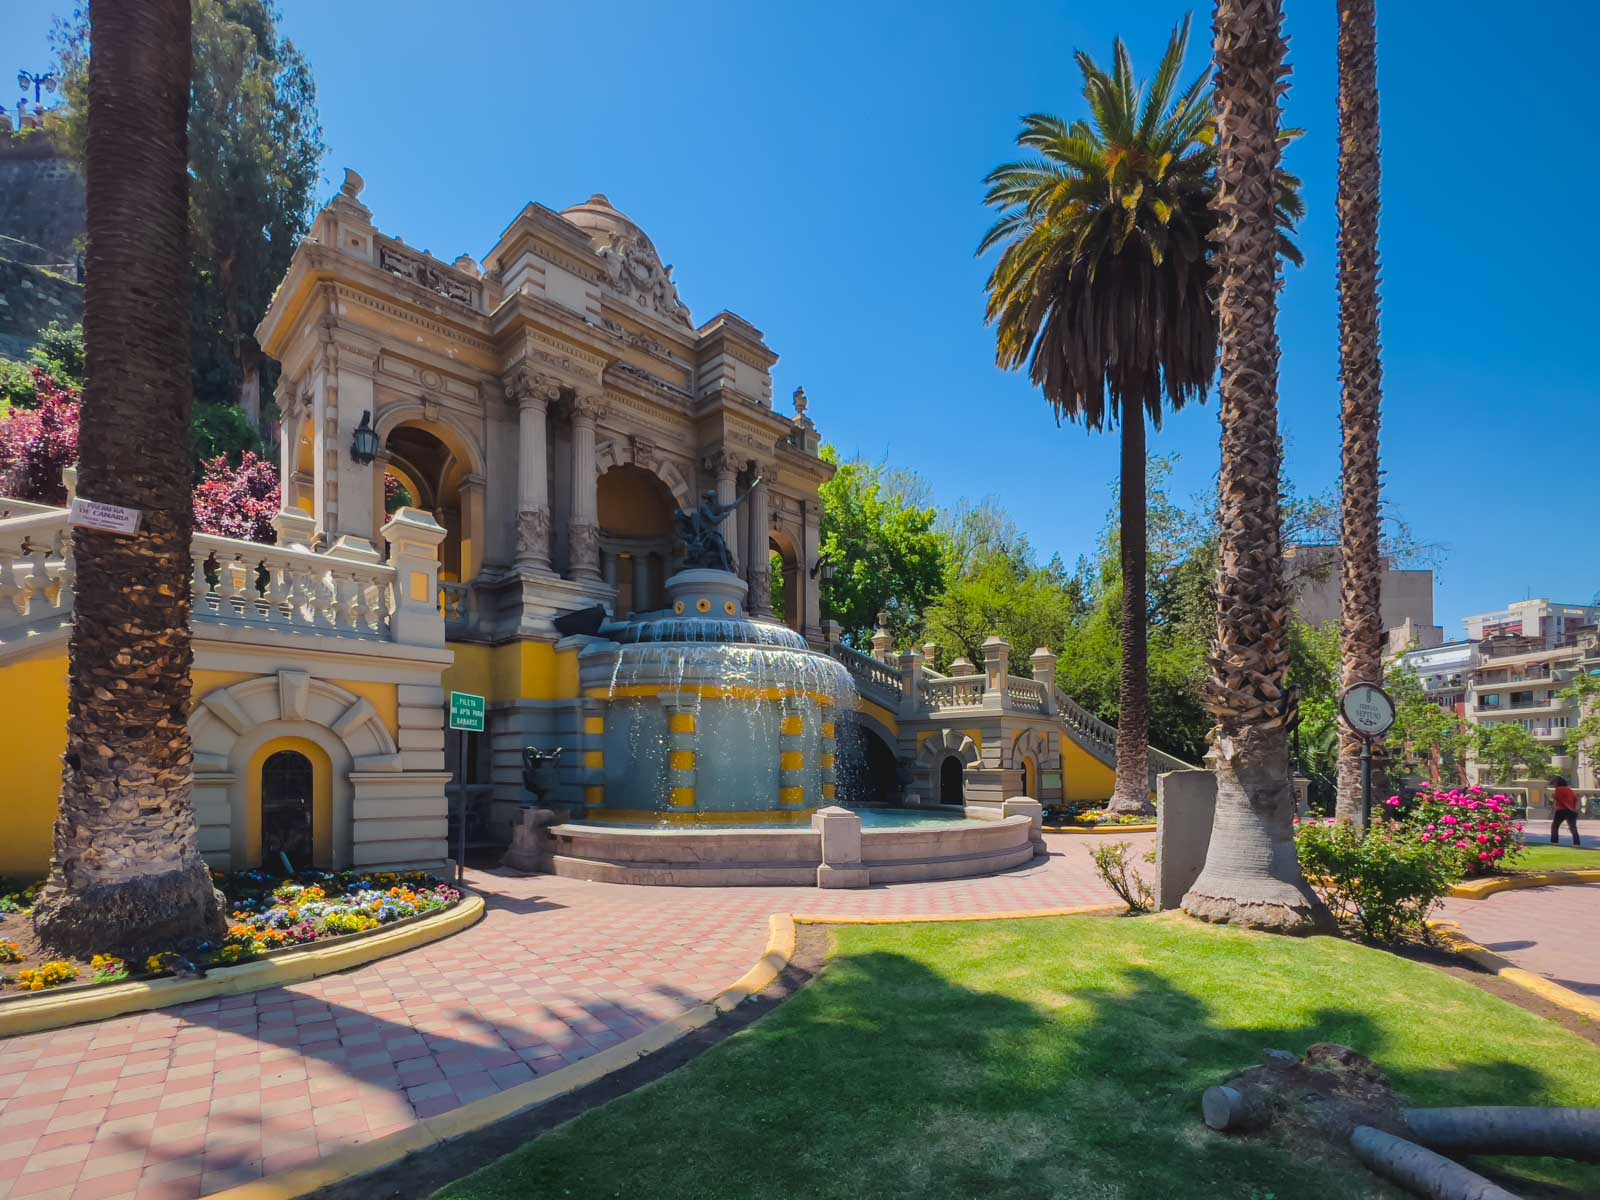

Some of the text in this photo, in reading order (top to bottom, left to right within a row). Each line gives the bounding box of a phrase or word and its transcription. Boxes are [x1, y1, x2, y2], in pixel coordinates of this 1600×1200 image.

[459, 698, 476, 707] PILETA
[459, 708, 471, 716] APTA
[1355, 709, 1381, 720] NEPTUNO
